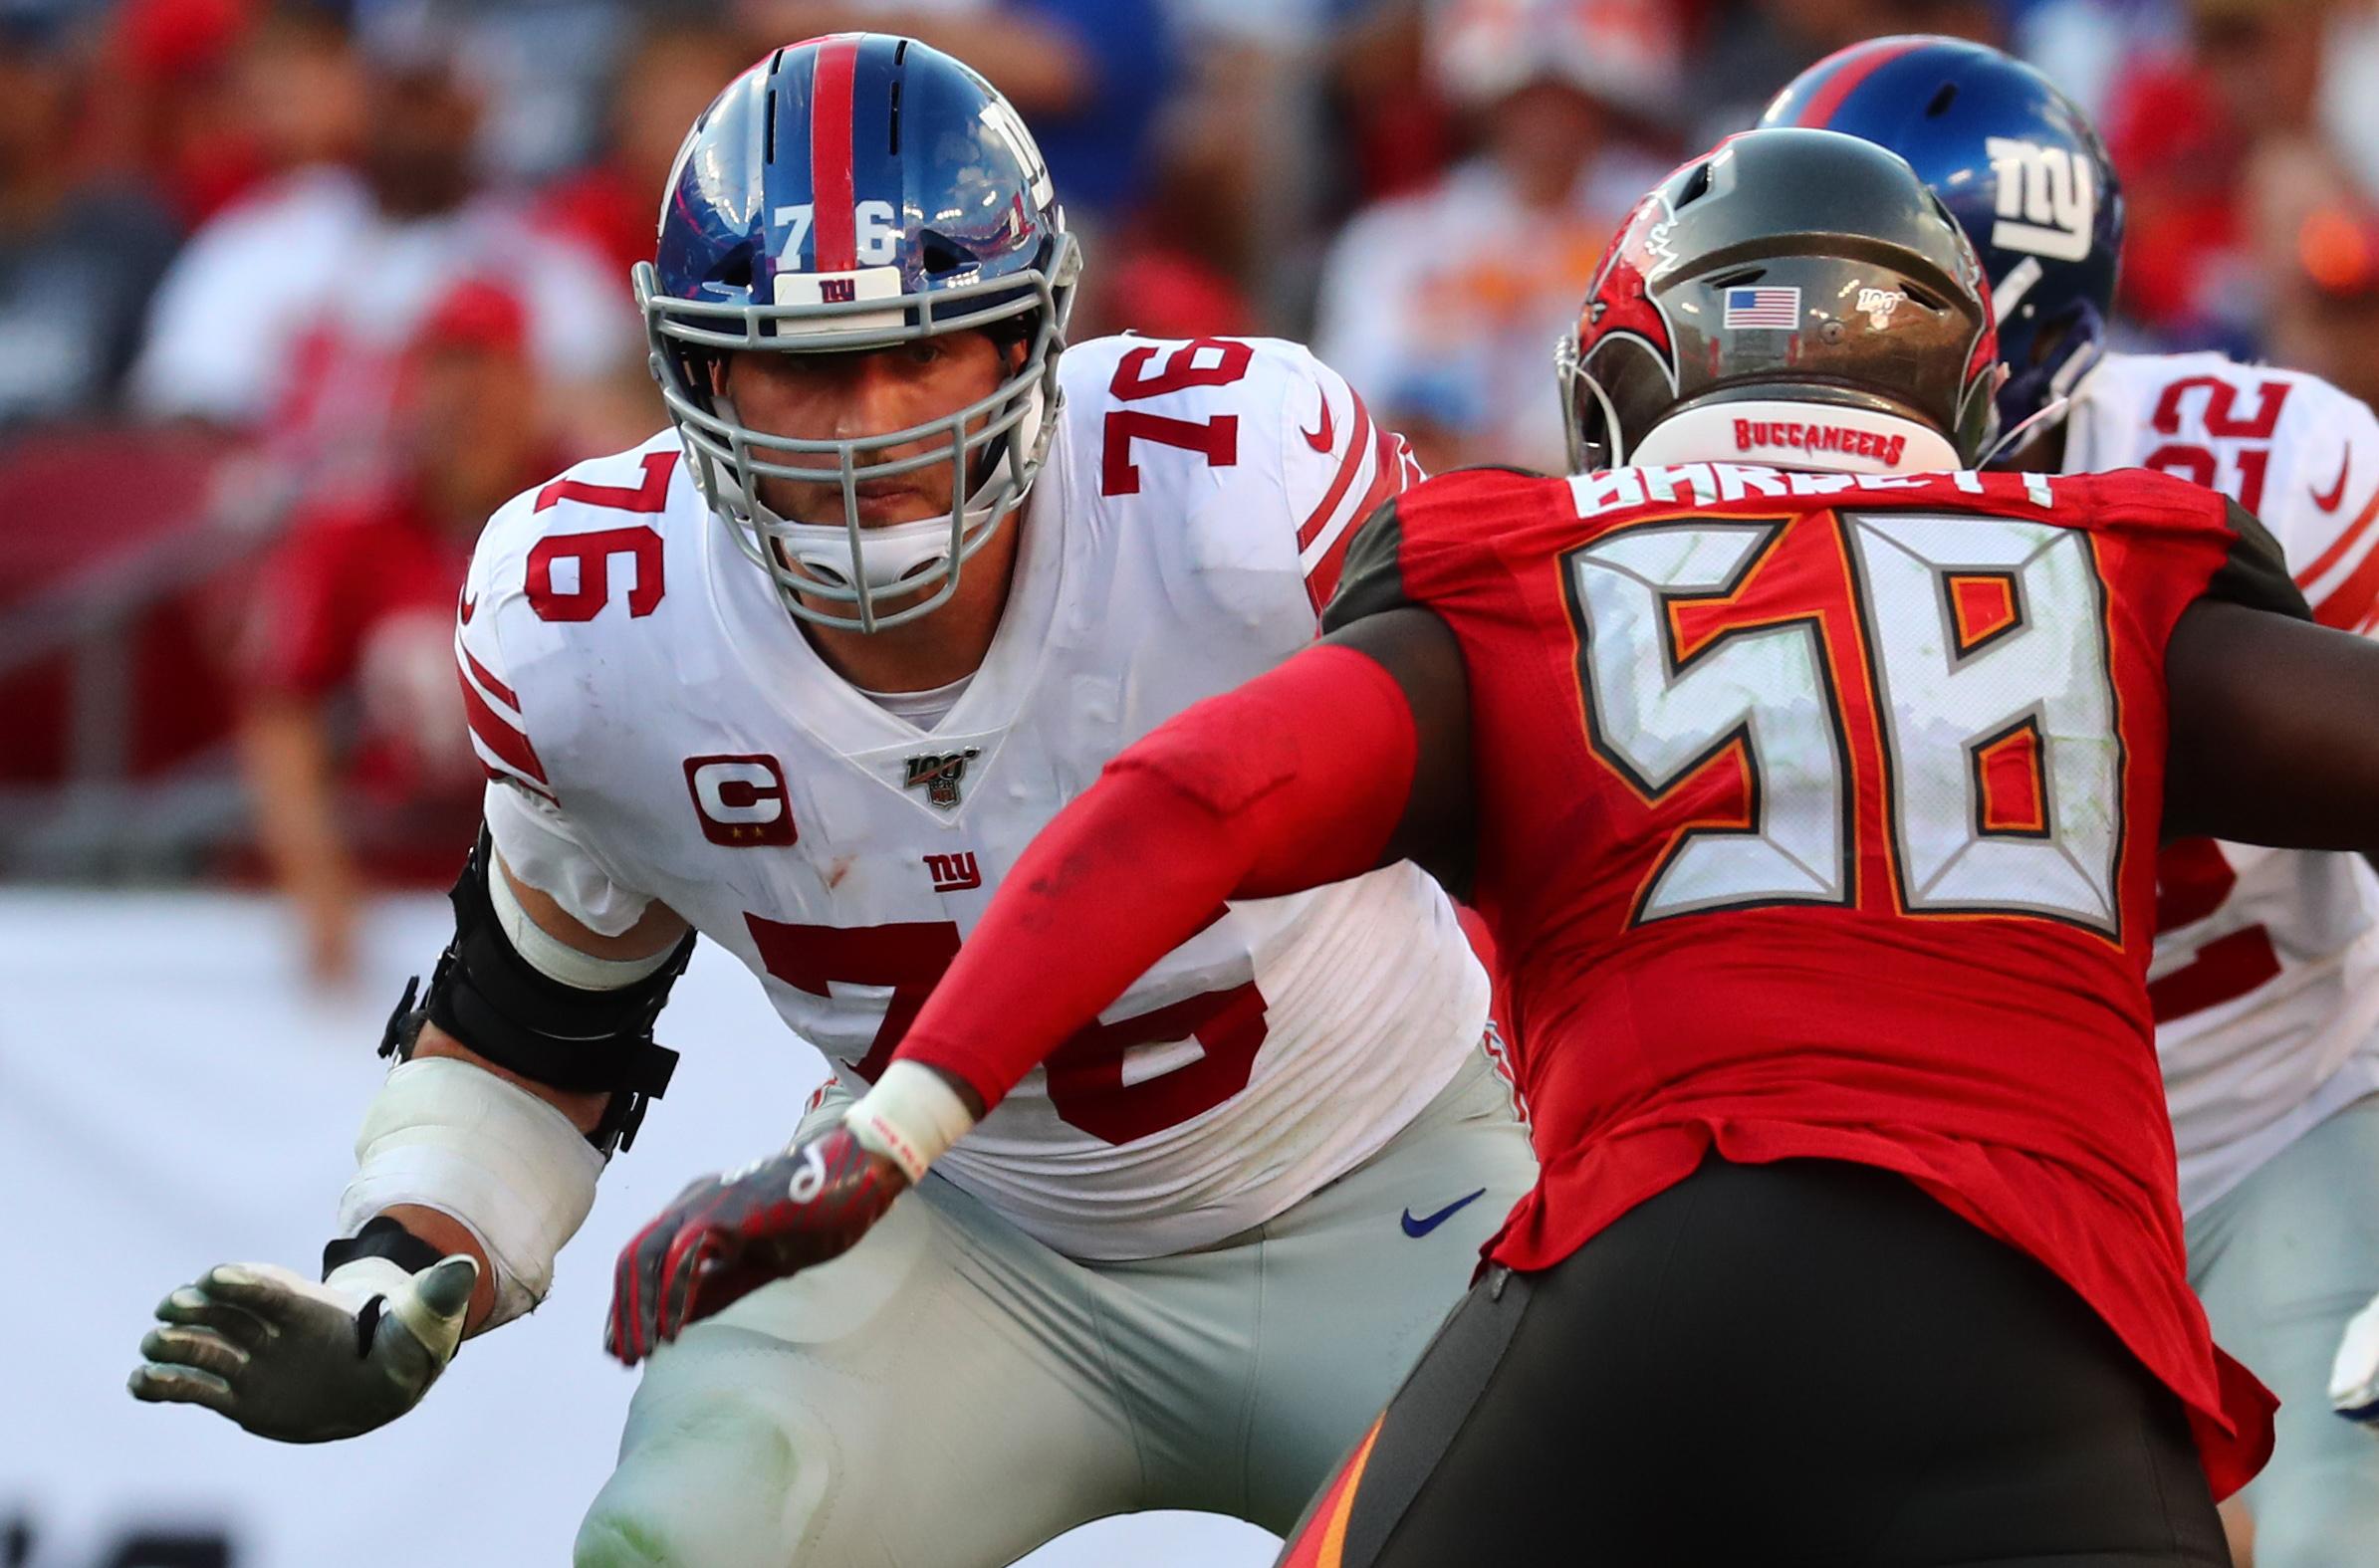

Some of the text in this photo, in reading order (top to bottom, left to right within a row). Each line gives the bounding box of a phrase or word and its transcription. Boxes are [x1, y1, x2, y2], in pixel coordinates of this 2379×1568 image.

[774, 200, 896, 272] 76
[1101, 335, 1254, 497] 76
[1733, 418, 1907, 467] BUCCANEERS
[524, 449, 681, 623] 76
[1557, 509, 2128, 953] 58
[694, 763, 782, 824] C
